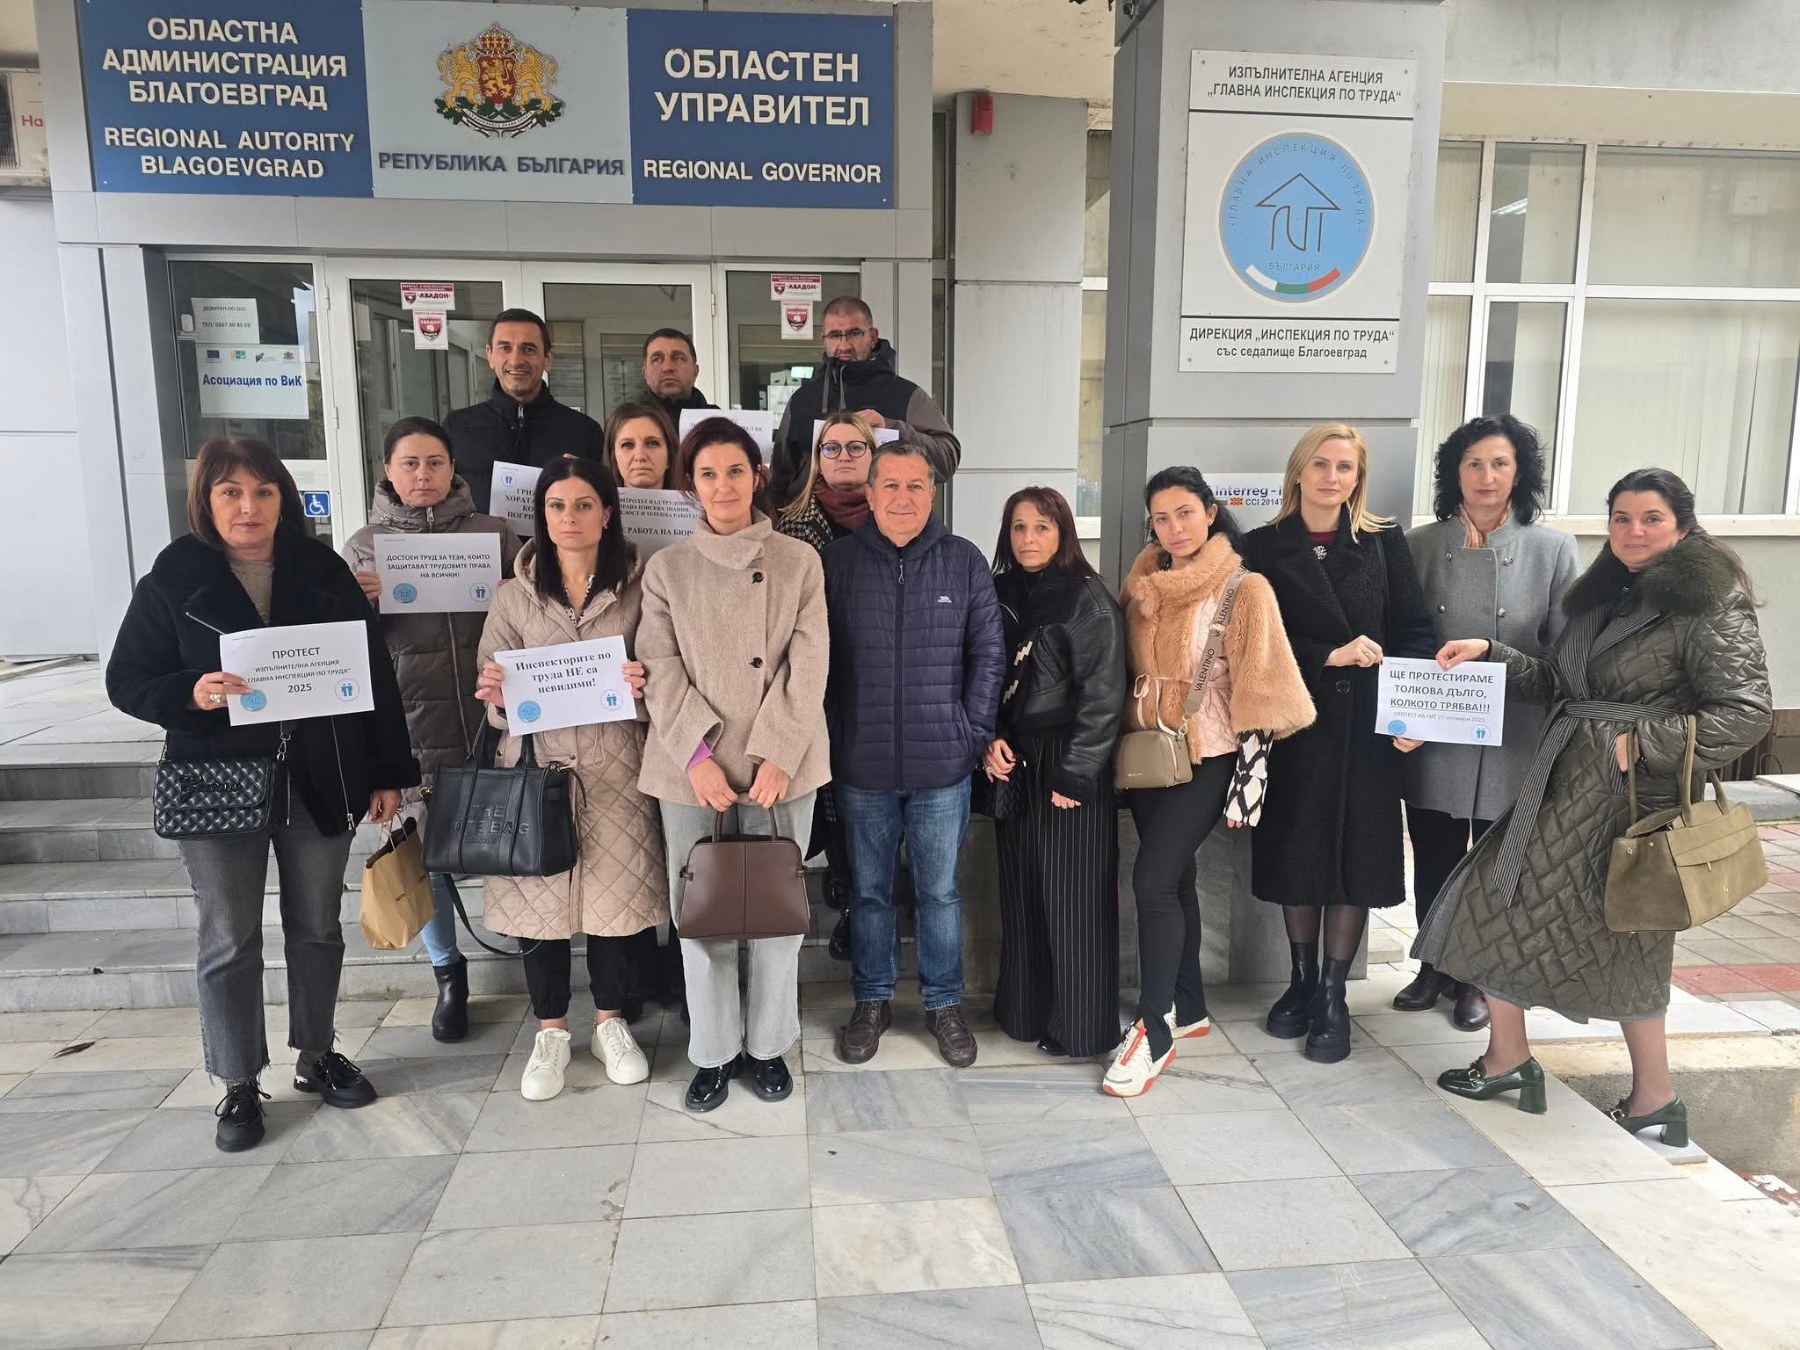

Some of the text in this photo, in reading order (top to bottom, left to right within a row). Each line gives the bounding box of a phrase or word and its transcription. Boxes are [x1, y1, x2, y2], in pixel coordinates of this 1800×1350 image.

[148, 17, 298, 44] ОБЛАСТНА
[102, 48, 347, 79] АДМИНИСТРАЦИЯ
[664, 48, 859, 83] ОБЛАСТЕН
[1229, 66, 1383, 85] ИЗПЪЛНИТЕЛНА АГЕНЦИЯ
[129, 80, 328, 111] БЛАГОЕВГРАД
[1207, 83, 1401, 104] „ГЛАВНА ИНСПЕКЦИЯ ПО ТРУДА“
[654, 91, 869, 126] УПРАВИТЕЛ
[21, 114, 44, 127] Ha
[104, 127, 355, 152] REGIONAL AUTORITY
[140, 155, 324, 178] BLAGOEVGRAD
[378, 152, 625, 176] РЕПУБЛИКА БЪЛГАРИЯ
[643, 159, 882, 183] REGIONAL GOVERNOR
[1229, 143, 1366, 225] ГЛАВНА ИНСПЕКЦИЯ ПО ТРУДА
[1269, 261, 1320, 271] БЪЛГАРИЯ
[1189, 328, 1394, 343] ДИРЕКЦИЯ „ИНСПЕКЦИЯ ПО ТРУДА“
[1216, 346, 1367, 360] със седалище Благоевград
[202, 374, 302, 388] Асоциация по ВиК
[1245, 498, 1284, 506] CCI 2014T
[627, 527, 659, 535] РАБОТА
[673, 529, 694, 537] БЮР
[386, 554, 419, 562] ДОСТОЕН
[272, 646, 320, 659] ПРОТЕСТ
[255, 660, 340, 673] ИЗПЪЛНИТЕЛНА АГЕНЦИЯ
[515, 652, 611, 671] Инспекторите по
[1194, 648, 1215, 691] VALENTINO
[275, 672, 316, 681] ИНСПЕКЦИЯ
[531, 666, 598, 683] труда НЕ са
[1389, 670, 1494, 684] ЩЕ ПРОТЕСТИРАМЕ
[287, 683, 312, 694] 2025
[538, 678, 597, 694] невидими!
[1394, 684, 1487, 699] ТОЛКОВА ДЪЛГО,
[1390, 698, 1490, 713] КОЛКОТО ТРЯБВА!!!
